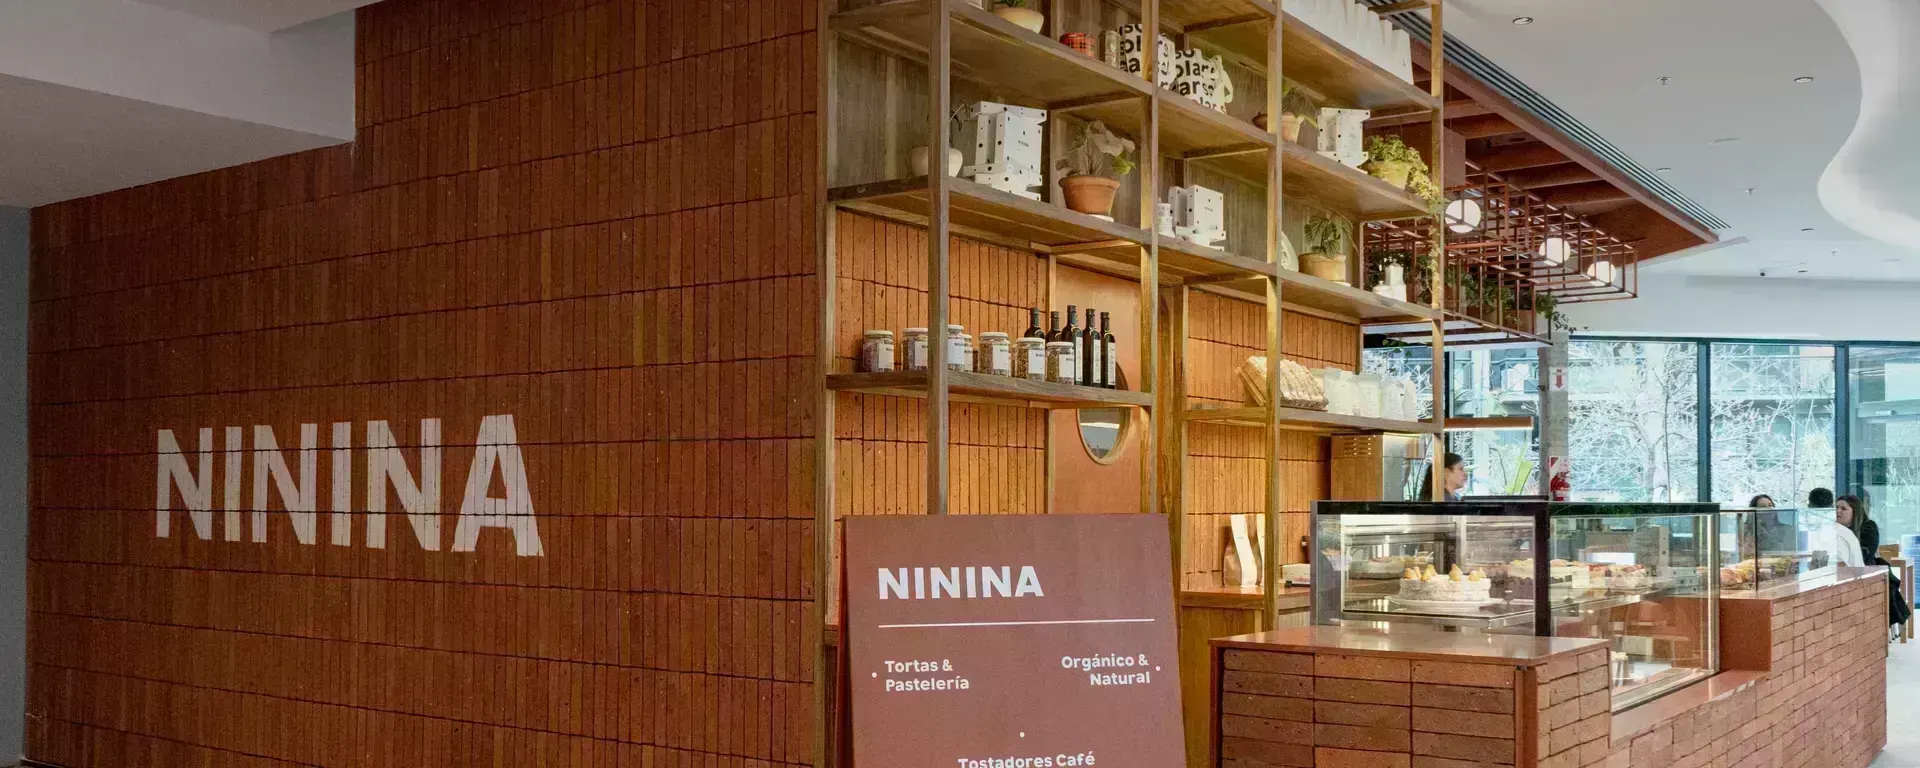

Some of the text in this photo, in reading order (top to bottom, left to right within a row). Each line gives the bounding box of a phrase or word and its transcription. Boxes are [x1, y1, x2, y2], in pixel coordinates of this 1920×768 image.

[156, 414, 544, 556] NININA
[878, 566, 1044, 599] NININA
[884, 659, 953, 672] Tortas &
[1061, 653, 1149, 671] Orgánico &
[885, 676, 969, 691] Pastelería
[1090, 672, 1150, 685] Natural
[958, 751, 1095, 768] Tostadores Café
